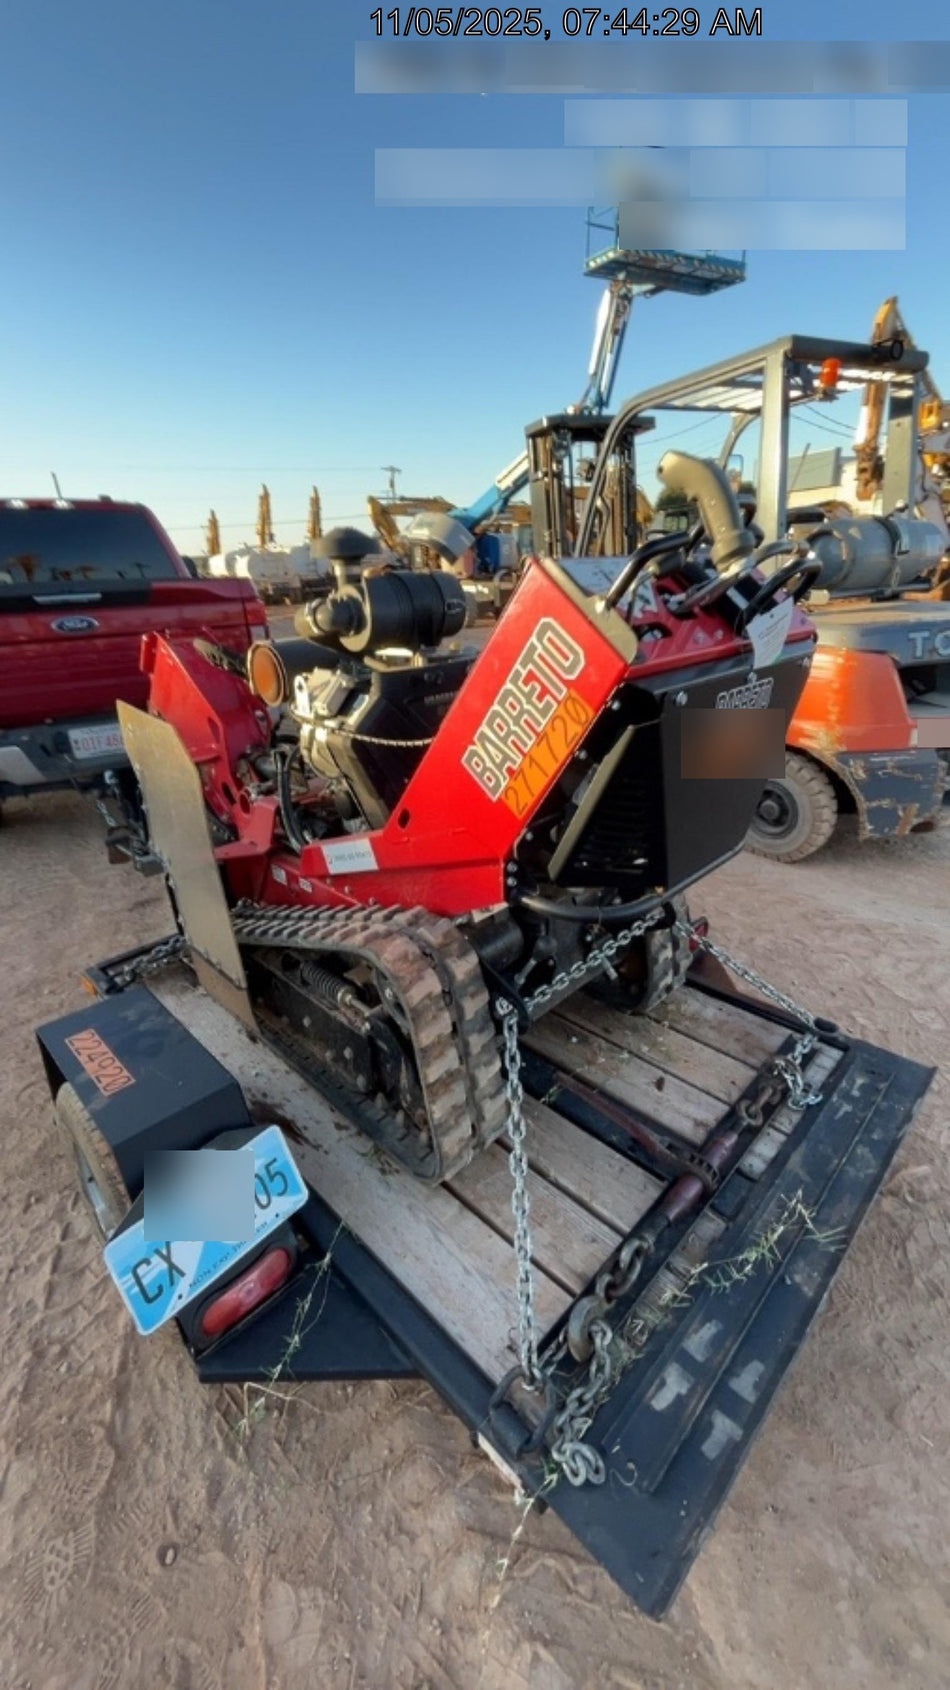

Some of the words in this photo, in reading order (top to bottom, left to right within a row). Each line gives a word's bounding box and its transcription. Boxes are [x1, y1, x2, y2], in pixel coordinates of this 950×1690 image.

[461, 617, 586, 802] BARRETO
[504, 695, 590, 816] 271720
[67, 1029, 133, 1092] 224920
